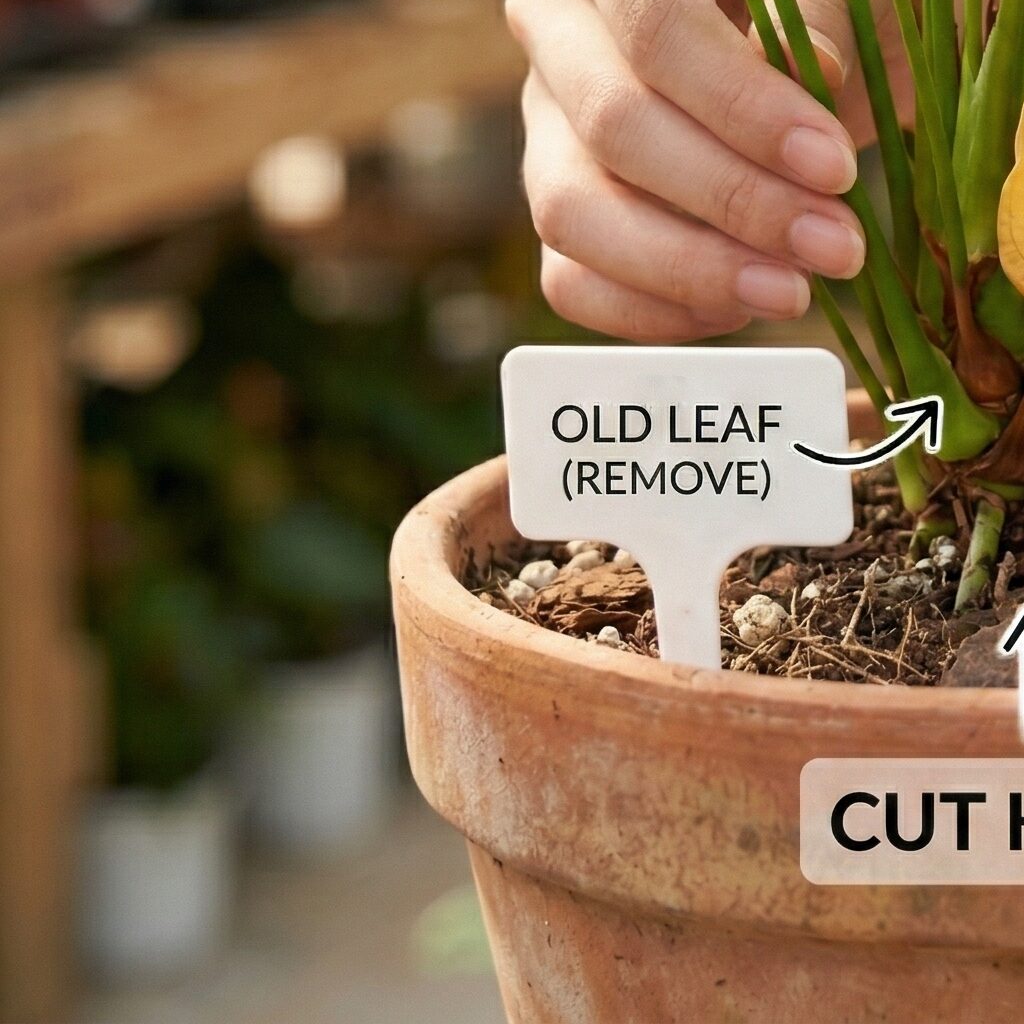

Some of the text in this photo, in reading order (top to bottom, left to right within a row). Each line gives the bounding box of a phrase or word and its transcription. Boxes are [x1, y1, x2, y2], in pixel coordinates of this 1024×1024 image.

[551, 404, 782, 443] OLD LEAF
[562, 458, 773, 502] (REMOVE)
